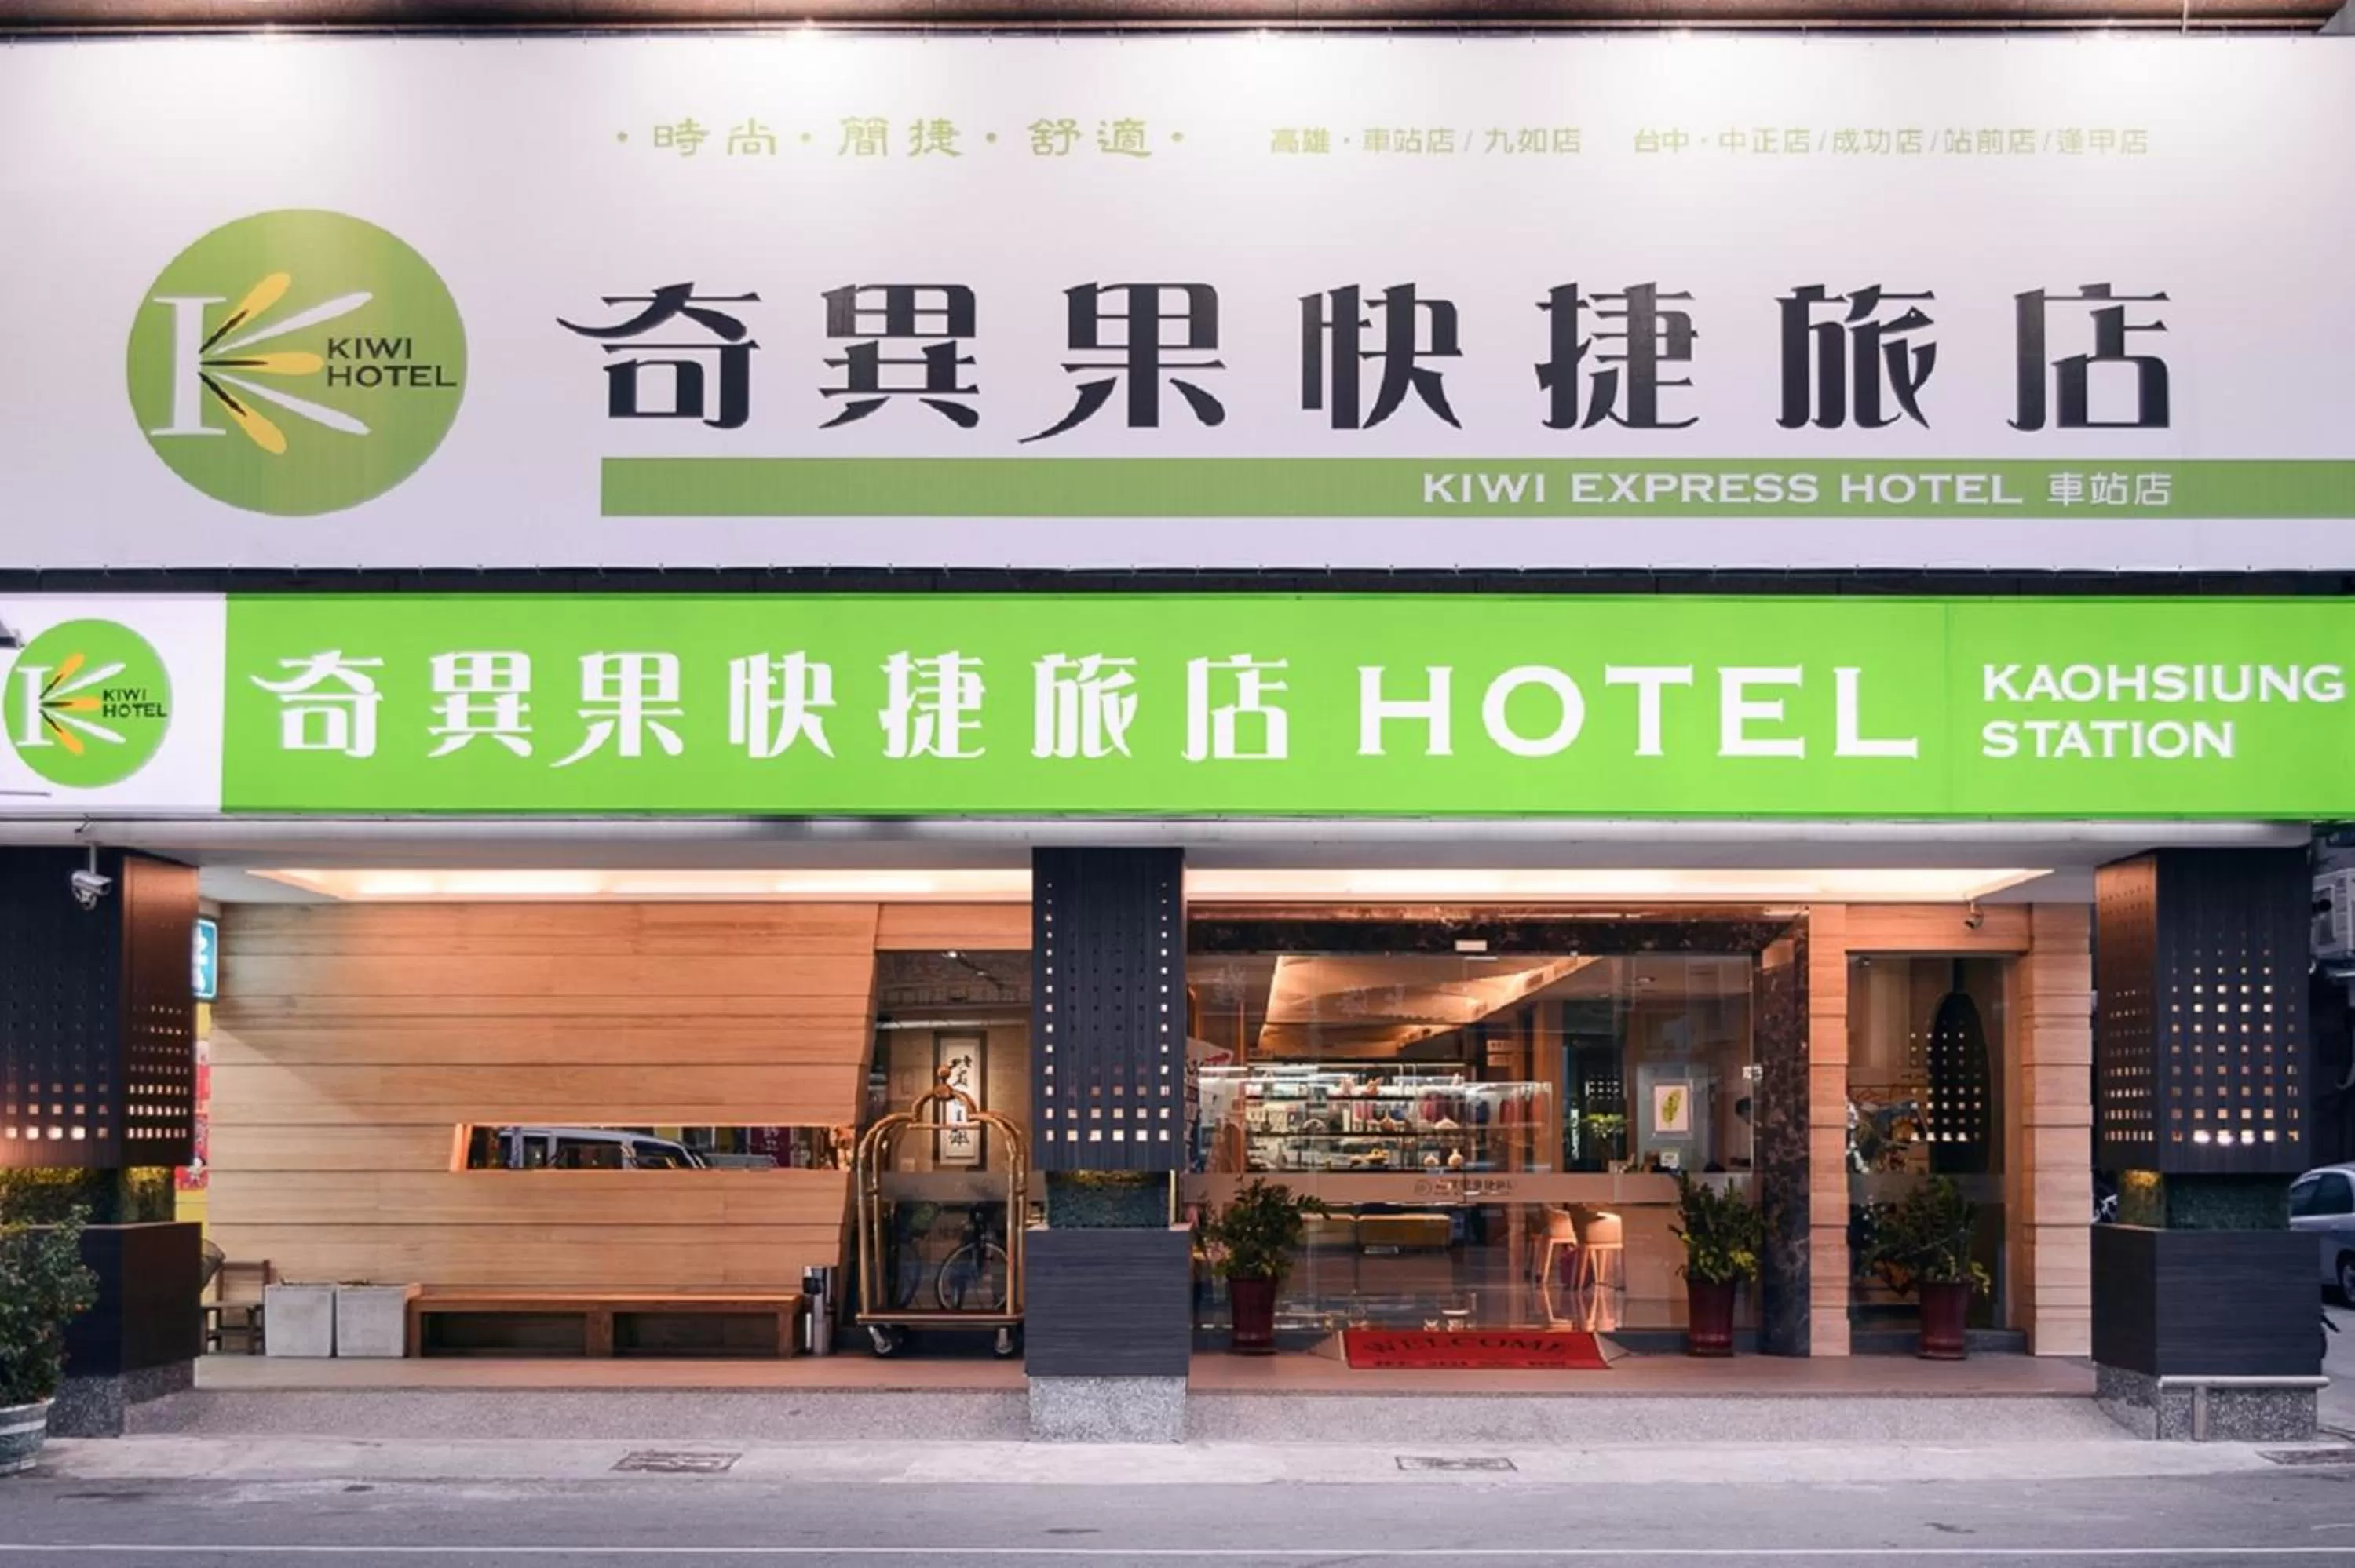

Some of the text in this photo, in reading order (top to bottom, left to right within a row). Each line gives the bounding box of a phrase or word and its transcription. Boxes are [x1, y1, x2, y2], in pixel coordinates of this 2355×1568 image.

[327, 337, 412, 359] KIWI
[556, 281, 2171, 444] 奇異果快捷旅店
[327, 365, 457, 387] HOTEL
[1422, 471, 2173, 507] KIWI EXPRESS HOTEL 車站店
[102, 688, 148, 702] KIWI
[1983, 664, 2346, 702] KAOHSIUNG
[102, 704, 168, 718] HOTEL
[250, 650, 1919, 768] 奇異果快捷旅店 HOTEL
[1982, 720, 2234, 758] STATION
